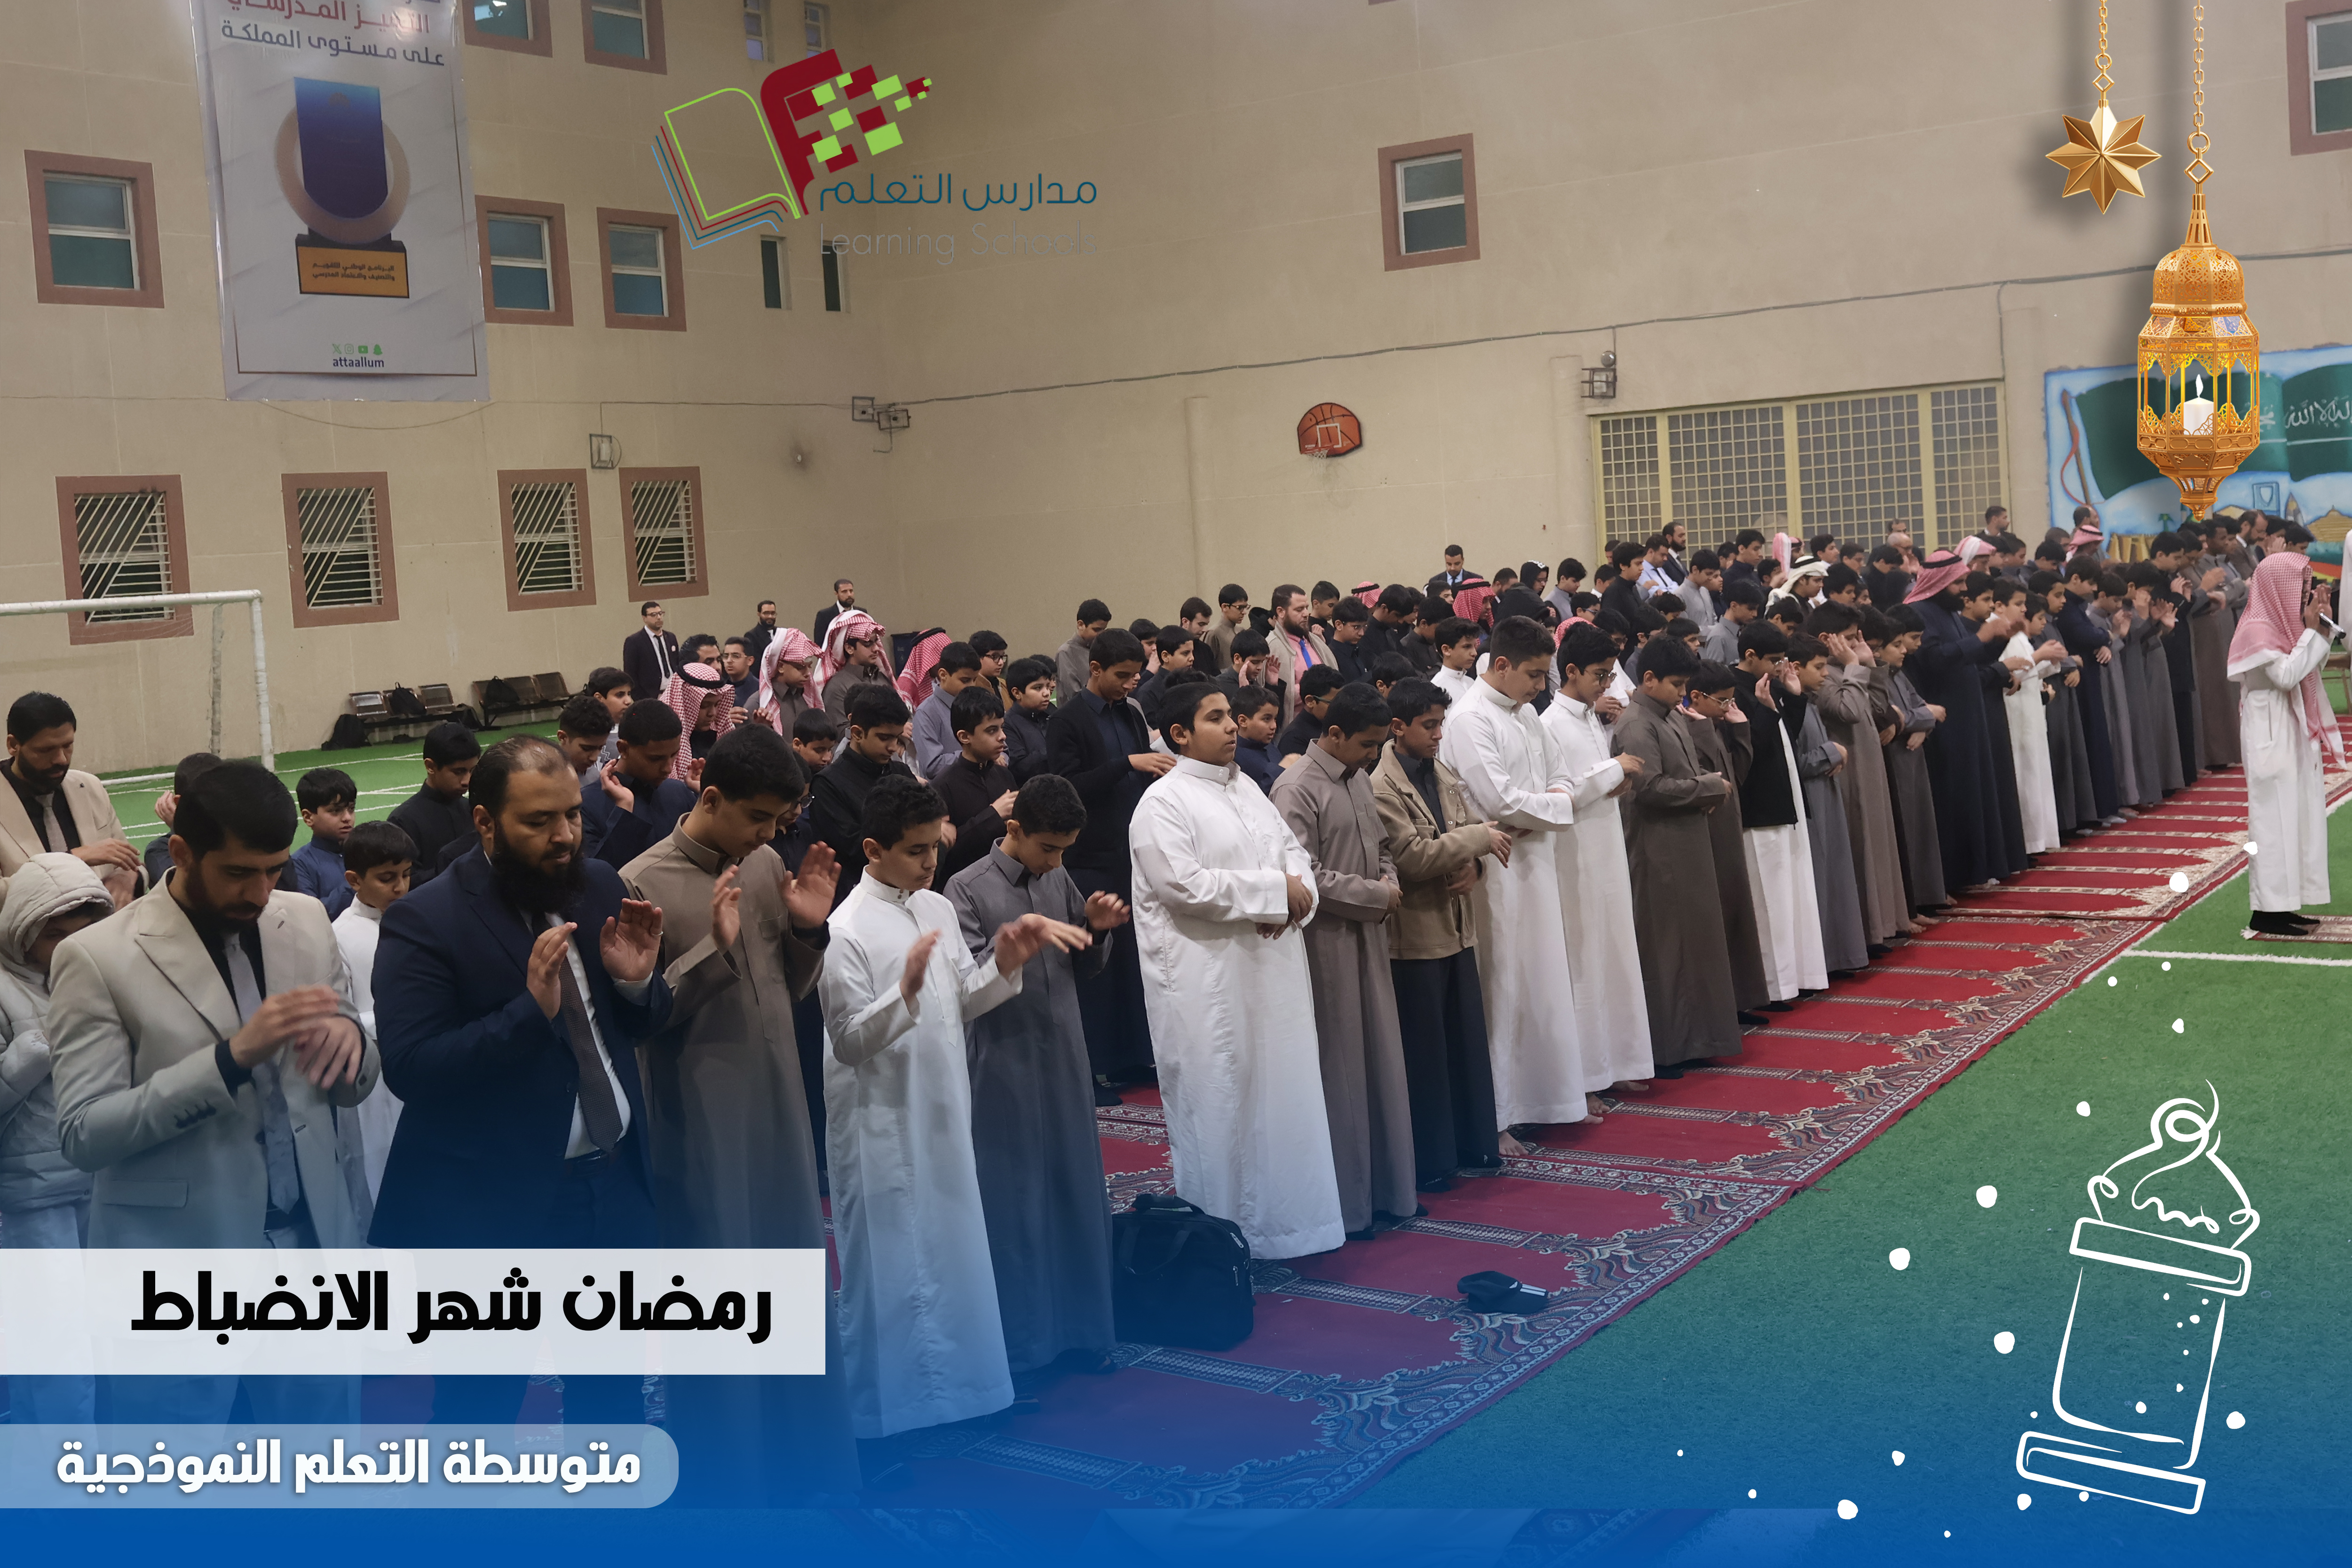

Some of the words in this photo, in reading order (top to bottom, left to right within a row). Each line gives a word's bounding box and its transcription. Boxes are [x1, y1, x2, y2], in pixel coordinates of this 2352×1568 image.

[222, 20, 301, 48] المملكة
[308, 36, 396, 59] مستوى
[403, 47, 444, 66] على
[333, 357, 384, 368] attaallum
